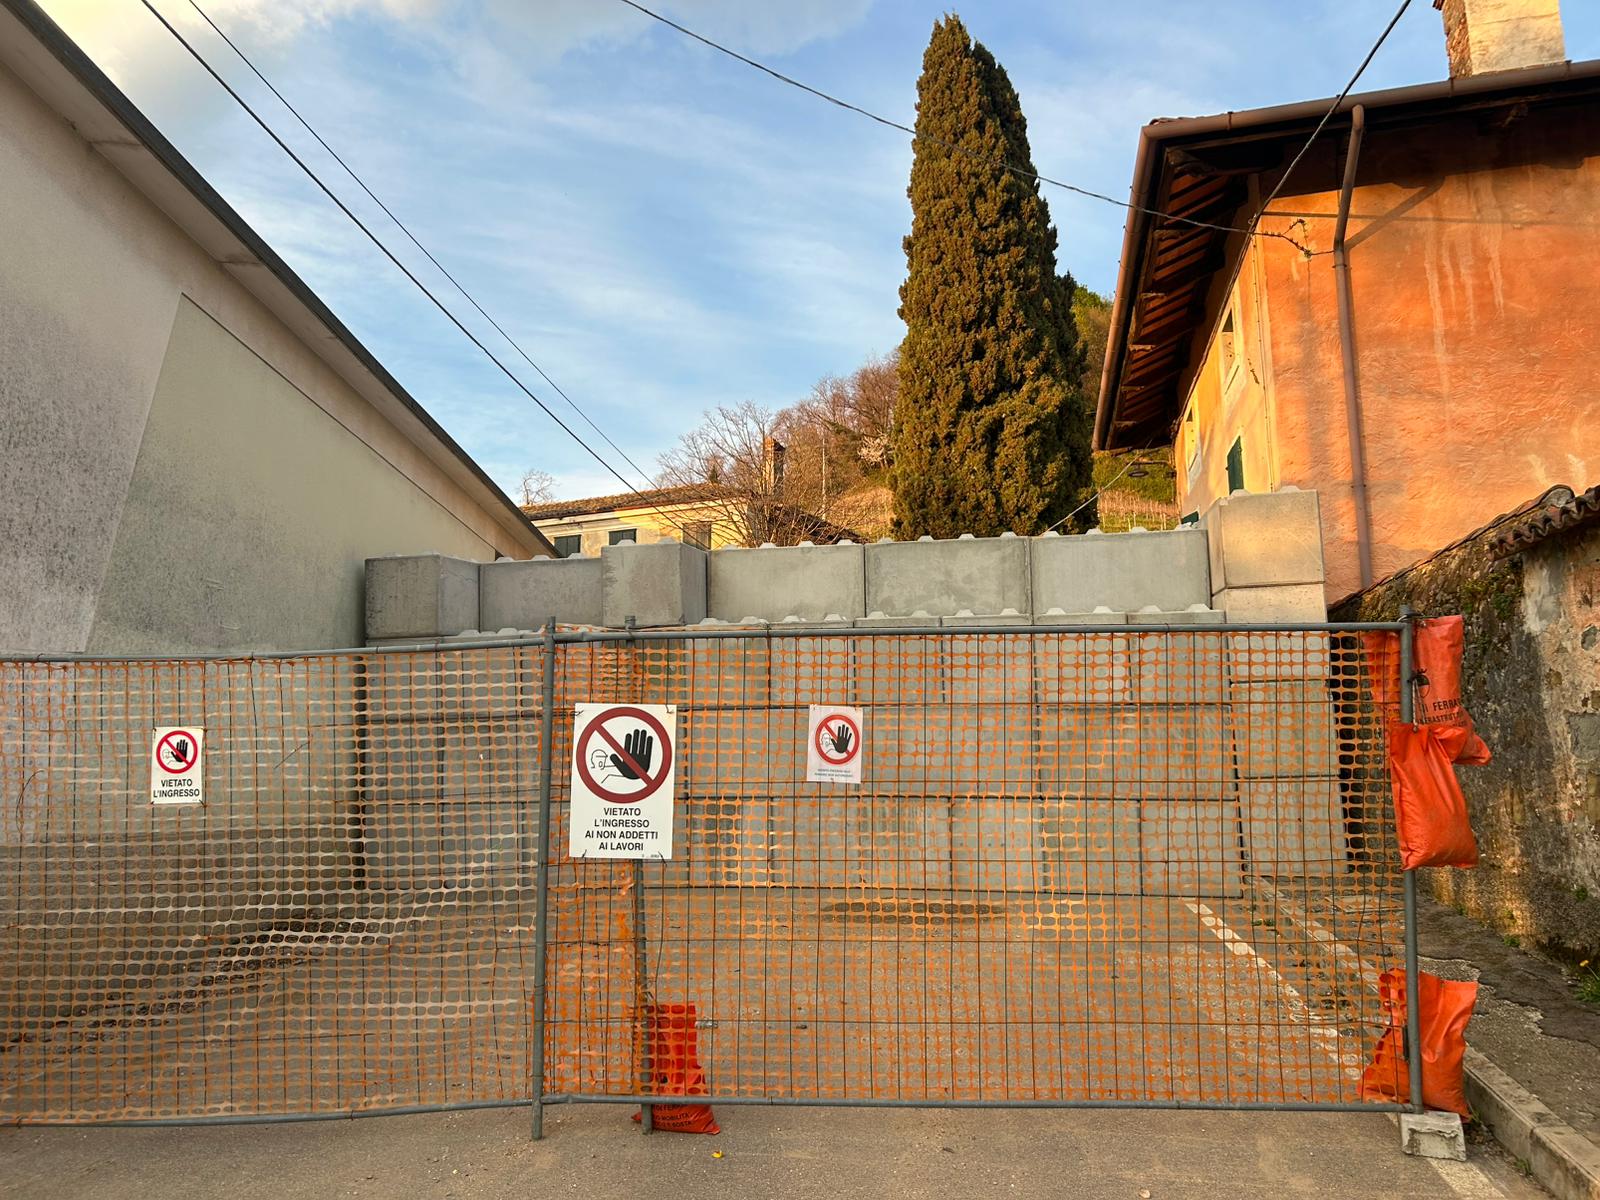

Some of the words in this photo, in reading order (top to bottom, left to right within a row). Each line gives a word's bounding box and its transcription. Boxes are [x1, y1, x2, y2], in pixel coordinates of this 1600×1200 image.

[161, 778, 193, 787] VIETATO
[153, 788, 200, 798] L'INGRESSO
[603, 807, 641, 816] VIETATO
[594, 818, 650, 828] L'INGRESSO
[585, 830, 594, 839] AI
[596, 830, 617, 839] NON
[619, 830, 658, 840] ADDETTI
[599, 842, 608, 850] AI
[610, 842, 644, 851] LAVORI
